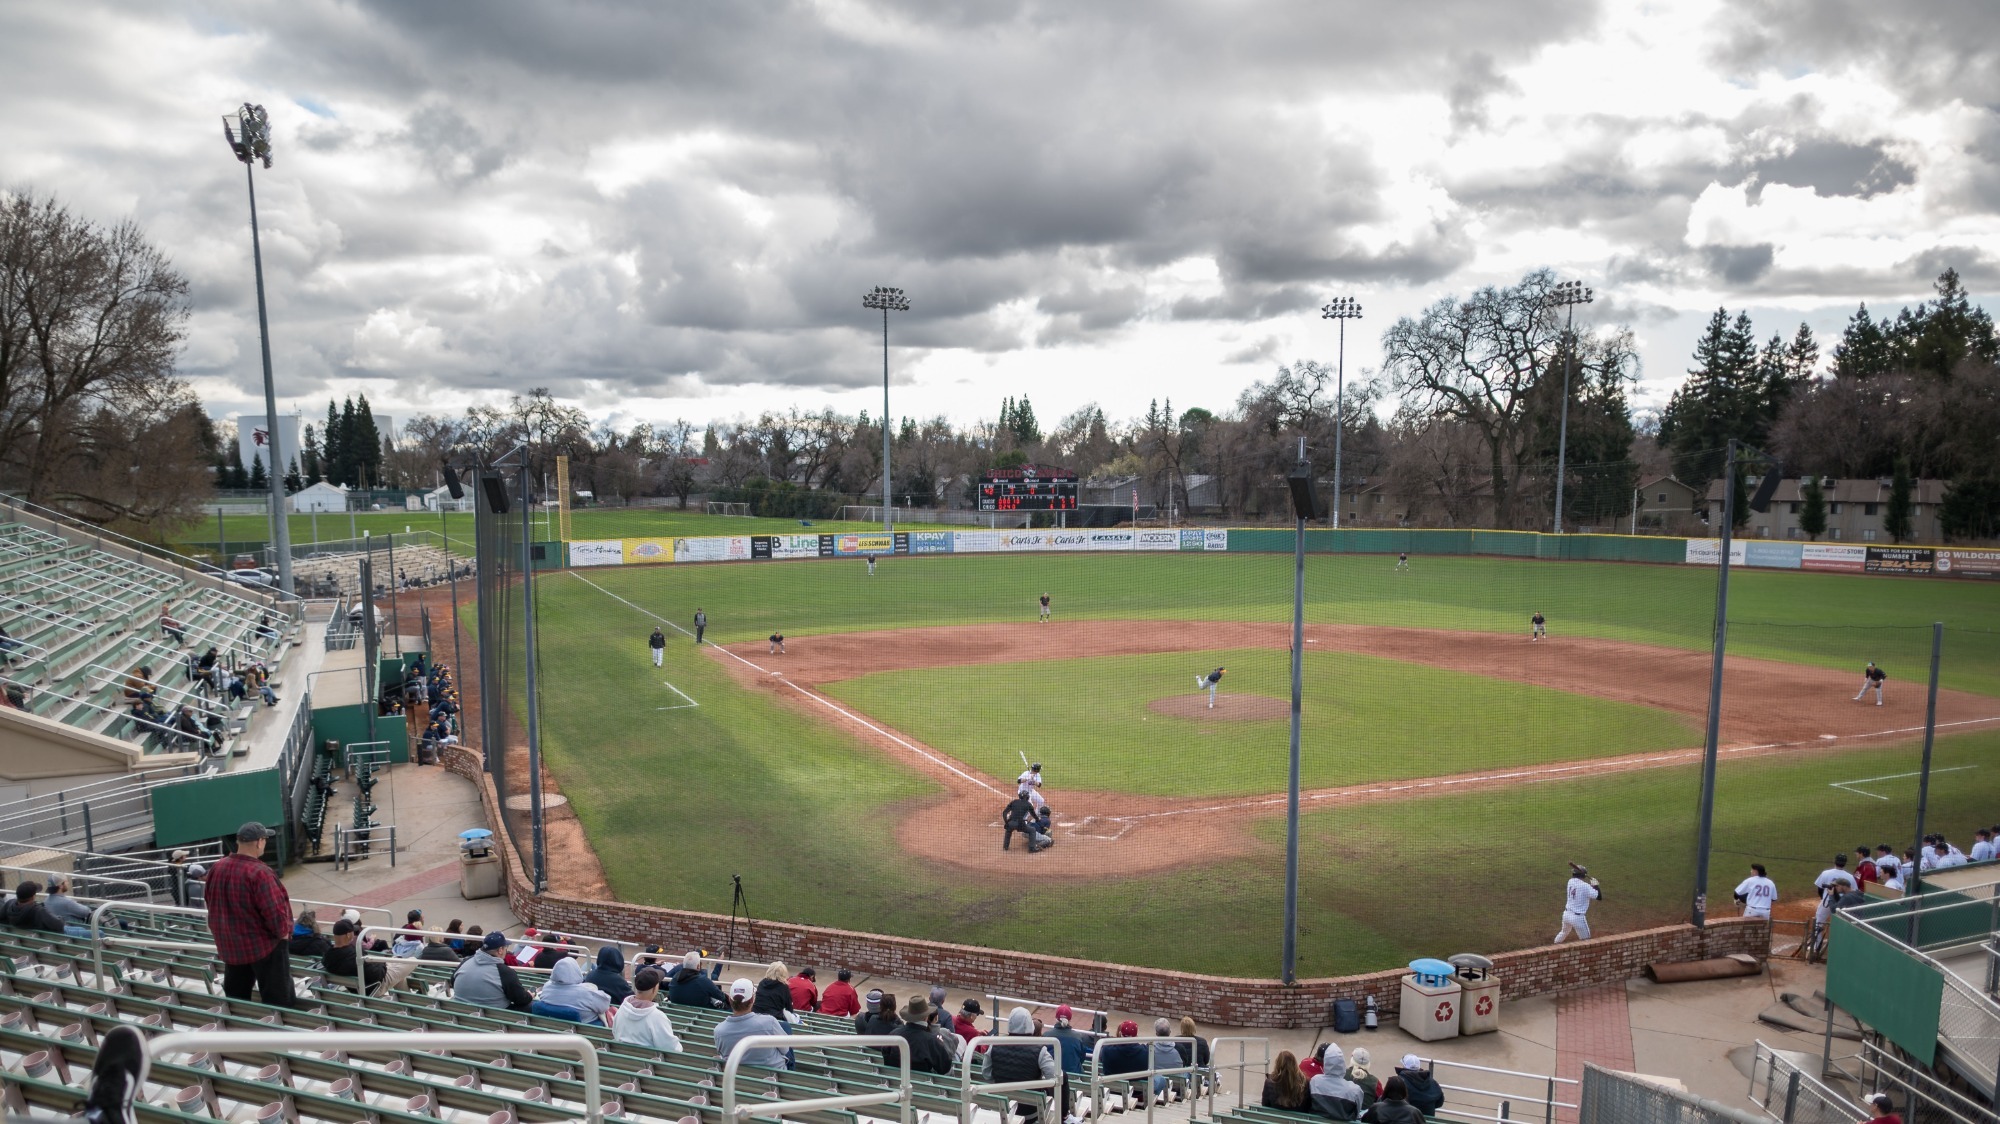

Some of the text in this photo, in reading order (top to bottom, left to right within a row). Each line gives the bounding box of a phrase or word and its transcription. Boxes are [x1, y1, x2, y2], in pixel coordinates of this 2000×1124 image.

[986, 469, 1022, 478] CHICO
[917, 533, 945, 541] KPAY
[771, 536, 782, 548] B
[790, 536, 818, 548] Line
[1953, 551, 2000, 560] WILDCATS
[1880, 560, 1933, 569] BLAZE
[1755, 885, 1771, 897] 20
